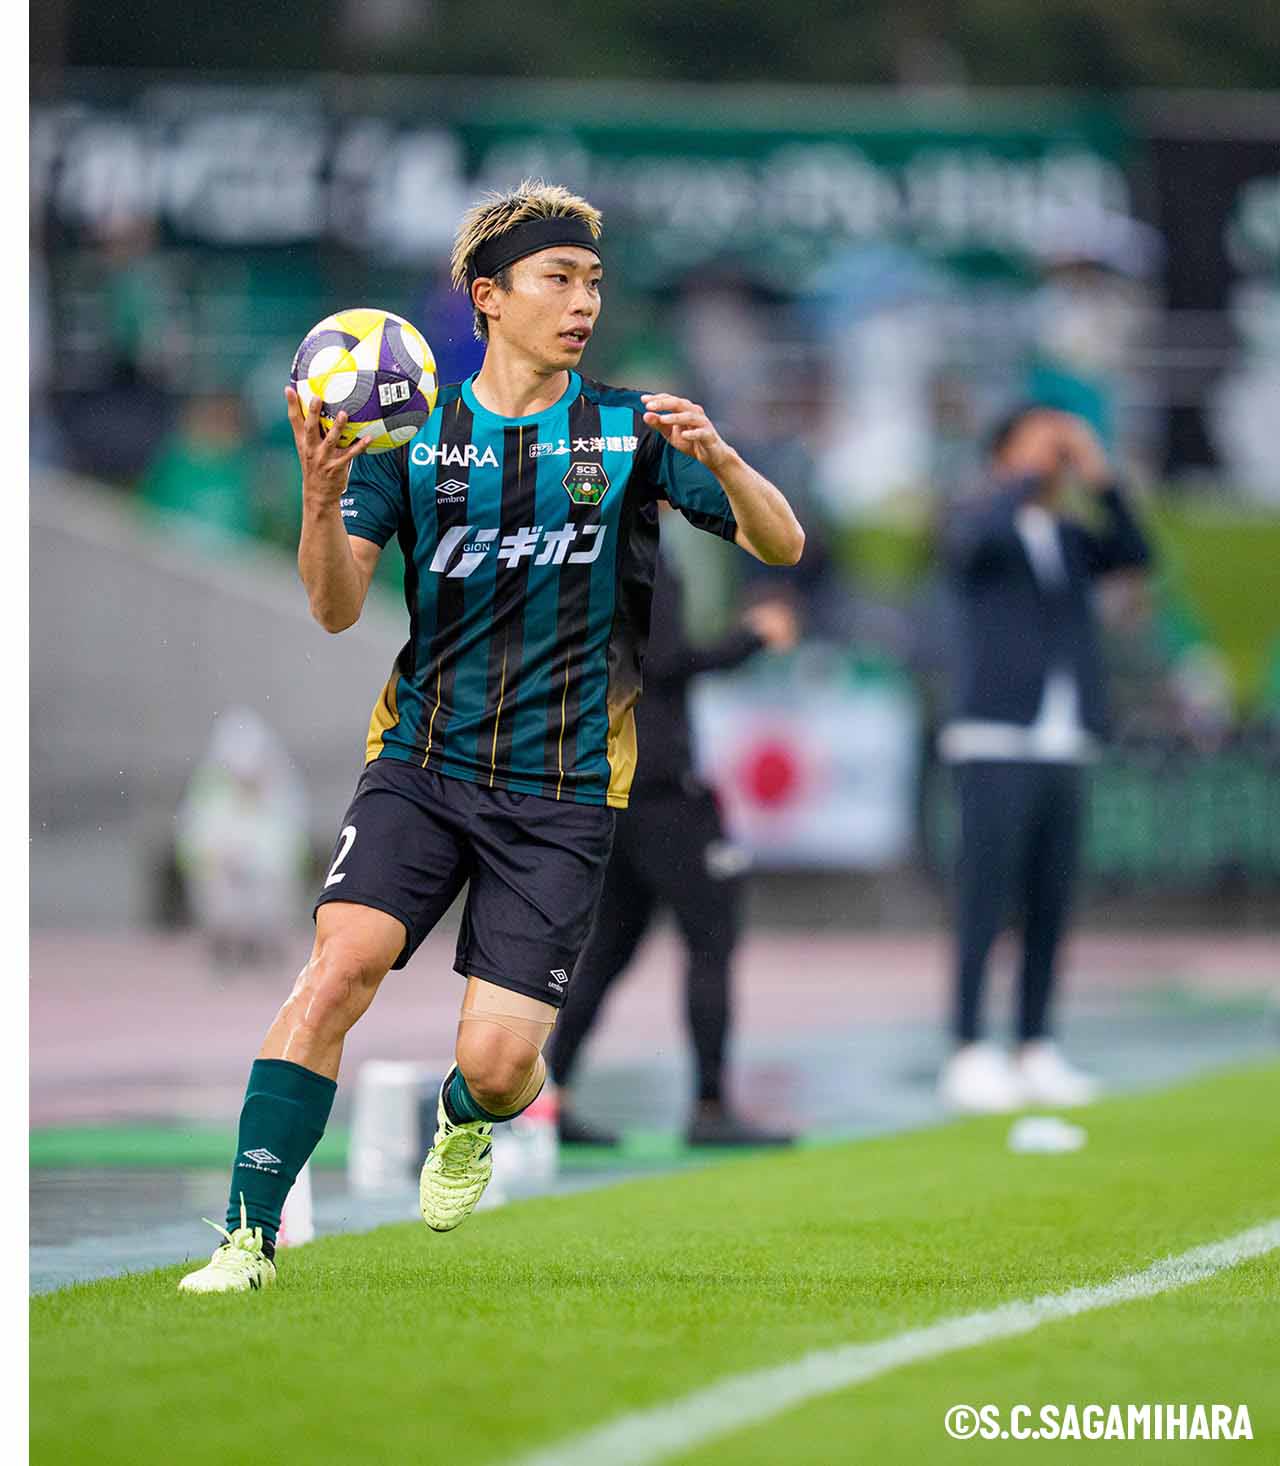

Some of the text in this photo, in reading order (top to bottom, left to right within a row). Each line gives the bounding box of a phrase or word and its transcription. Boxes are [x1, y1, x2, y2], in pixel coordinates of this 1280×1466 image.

[572, 436, 638, 453] 大洋建設
[411, 443, 499, 468] OHARA
[576, 466, 598, 474] SCS
[437, 496, 465, 504] umbro
[463, 543, 490, 552] GION
[497, 522, 608, 568] ギオン
[324, 825, 357, 889] 2
